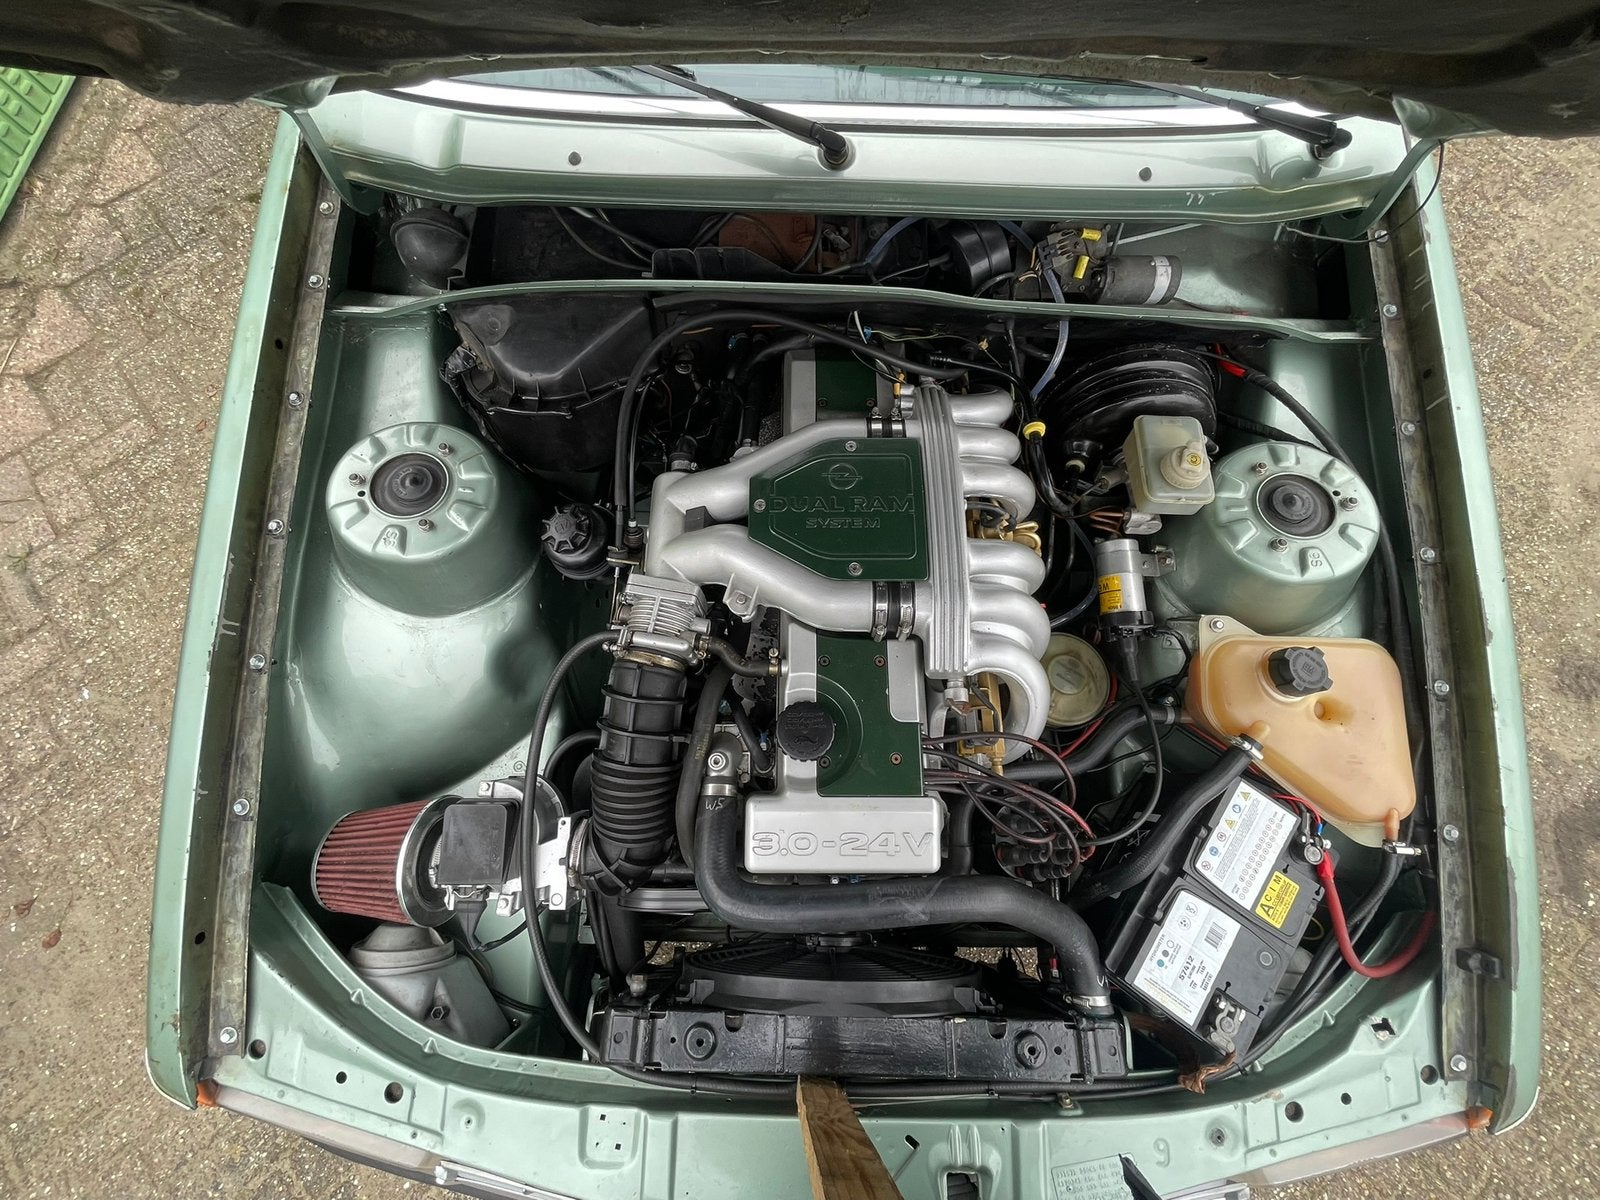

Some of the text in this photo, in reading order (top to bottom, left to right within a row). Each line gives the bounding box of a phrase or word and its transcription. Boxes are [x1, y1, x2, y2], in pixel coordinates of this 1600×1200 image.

[769, 496, 916, 513] DUAL RAM
[805, 517, 881, 529] SYSTEM
[752, 831, 934, 857] 3.0-24V
[1178, 955, 1195, 981] 57412
